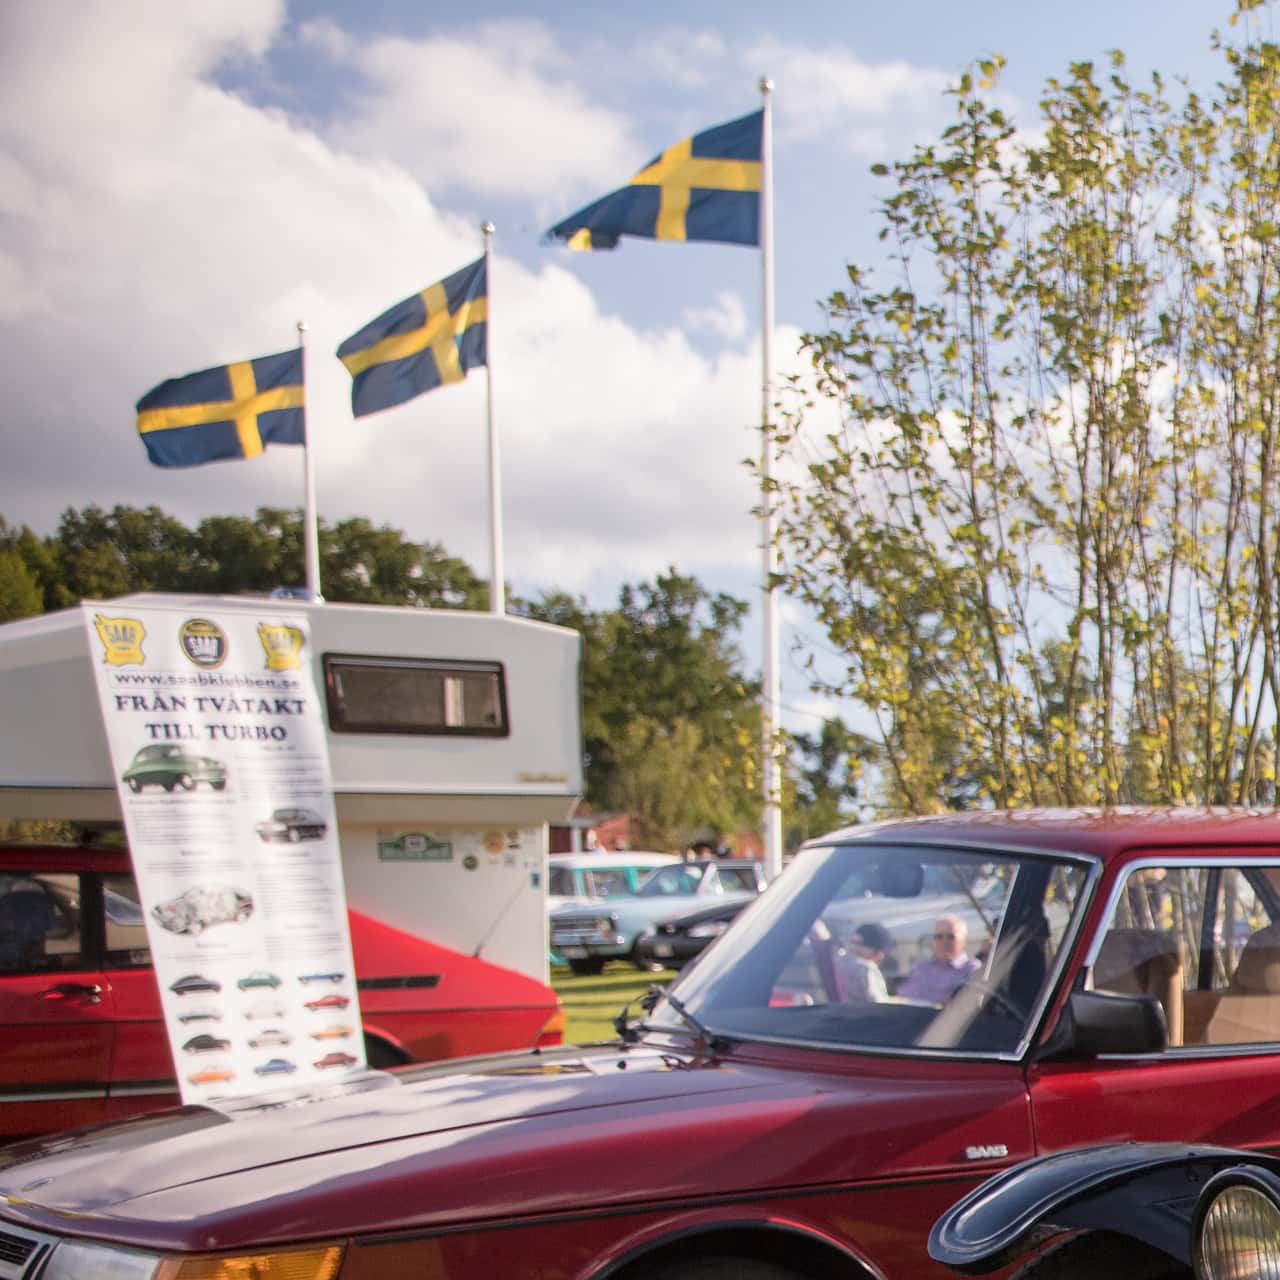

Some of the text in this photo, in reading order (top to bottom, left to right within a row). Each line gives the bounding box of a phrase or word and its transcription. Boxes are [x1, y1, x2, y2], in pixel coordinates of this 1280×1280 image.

[115, 691, 306, 715] FRÅN TVÅTAKT
[144, 723, 288, 741] TILL TURBO
[966, 1144, 1008, 1159] SAAB
